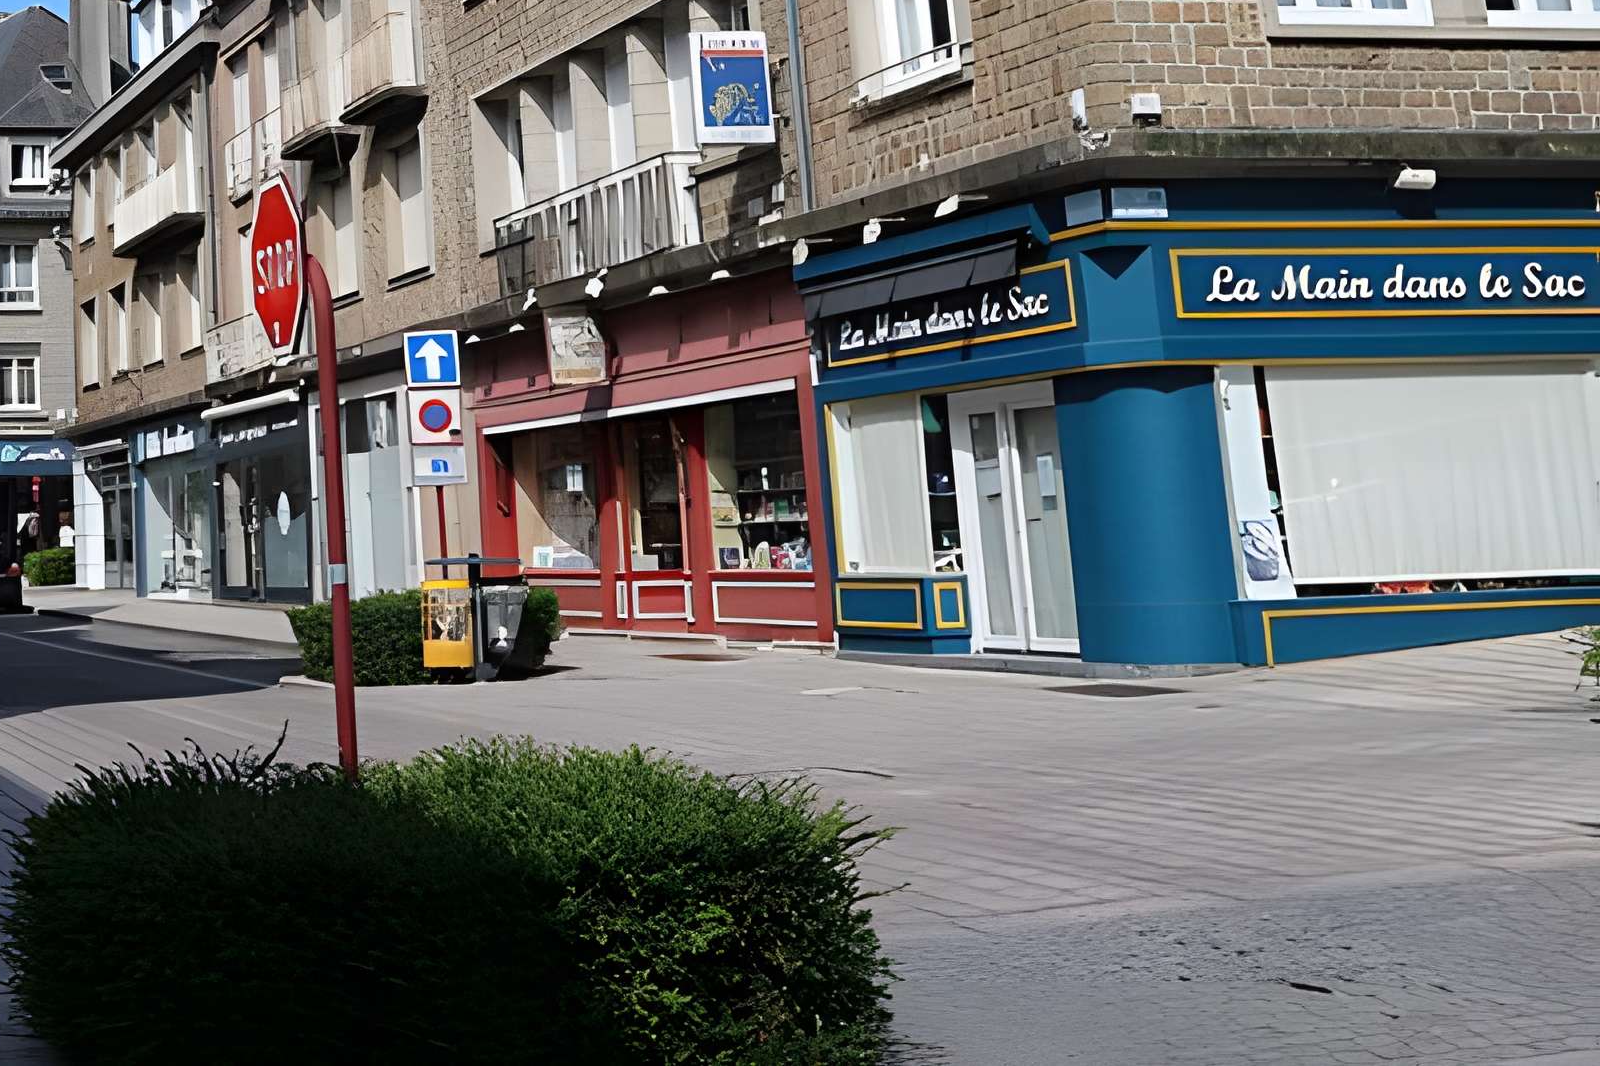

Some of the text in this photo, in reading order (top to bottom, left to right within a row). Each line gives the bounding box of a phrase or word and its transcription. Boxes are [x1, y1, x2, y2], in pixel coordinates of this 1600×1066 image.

[1206, 262, 1587, 302] La Main dans le Sac
[980, 292, 1004, 326] le
[1007, 285, 1050, 322] Sac
